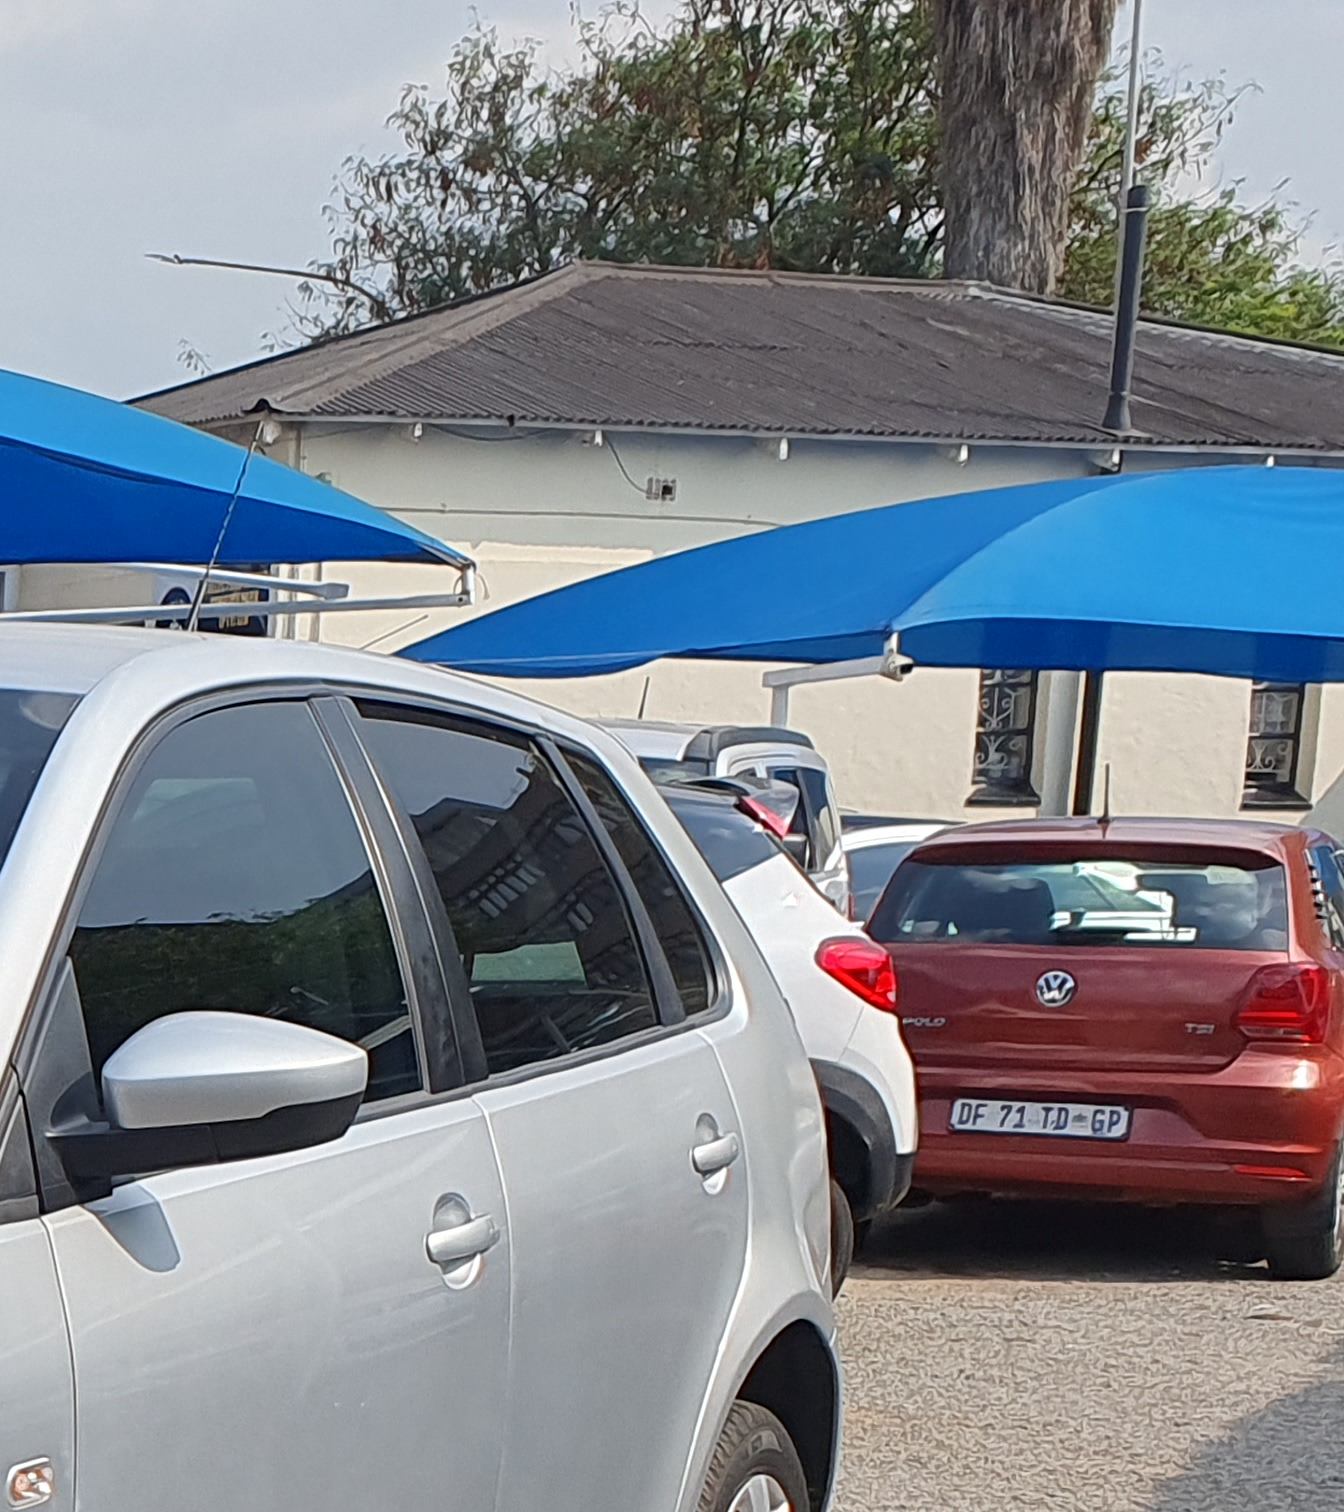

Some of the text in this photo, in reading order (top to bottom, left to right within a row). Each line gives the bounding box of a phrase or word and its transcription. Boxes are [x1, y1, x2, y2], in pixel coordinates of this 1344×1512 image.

[902, 1016, 947, 1028] POLO
[956, 1101, 1122, 1135] DF 71 TD GP
